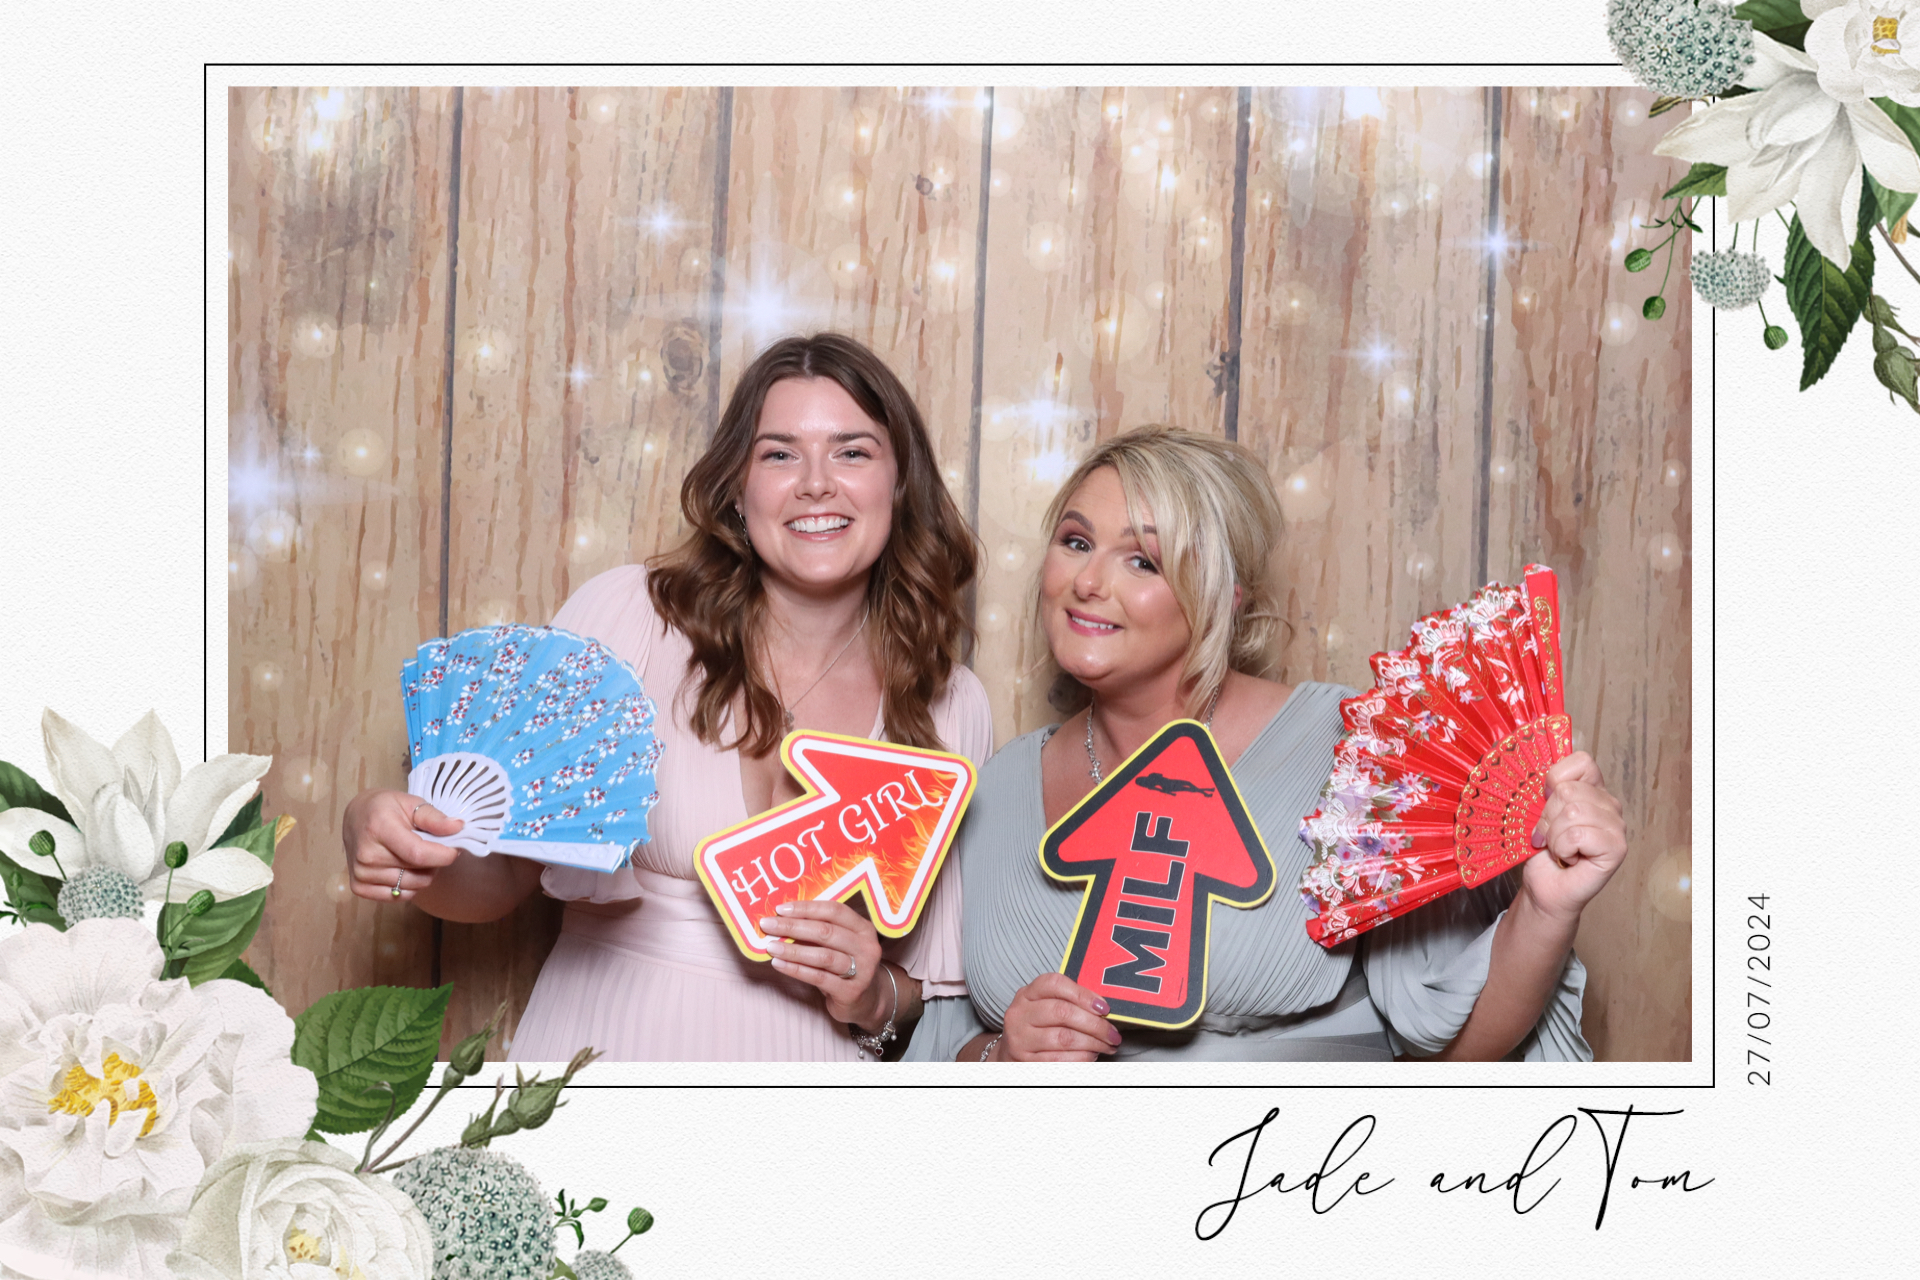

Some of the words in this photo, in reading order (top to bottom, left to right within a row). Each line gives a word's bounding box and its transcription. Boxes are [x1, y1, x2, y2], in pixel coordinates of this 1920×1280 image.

[731, 819, 832, 906] HOT
[837, 768, 945, 847] GIRL
[1100, 810, 1191, 995] MILF
